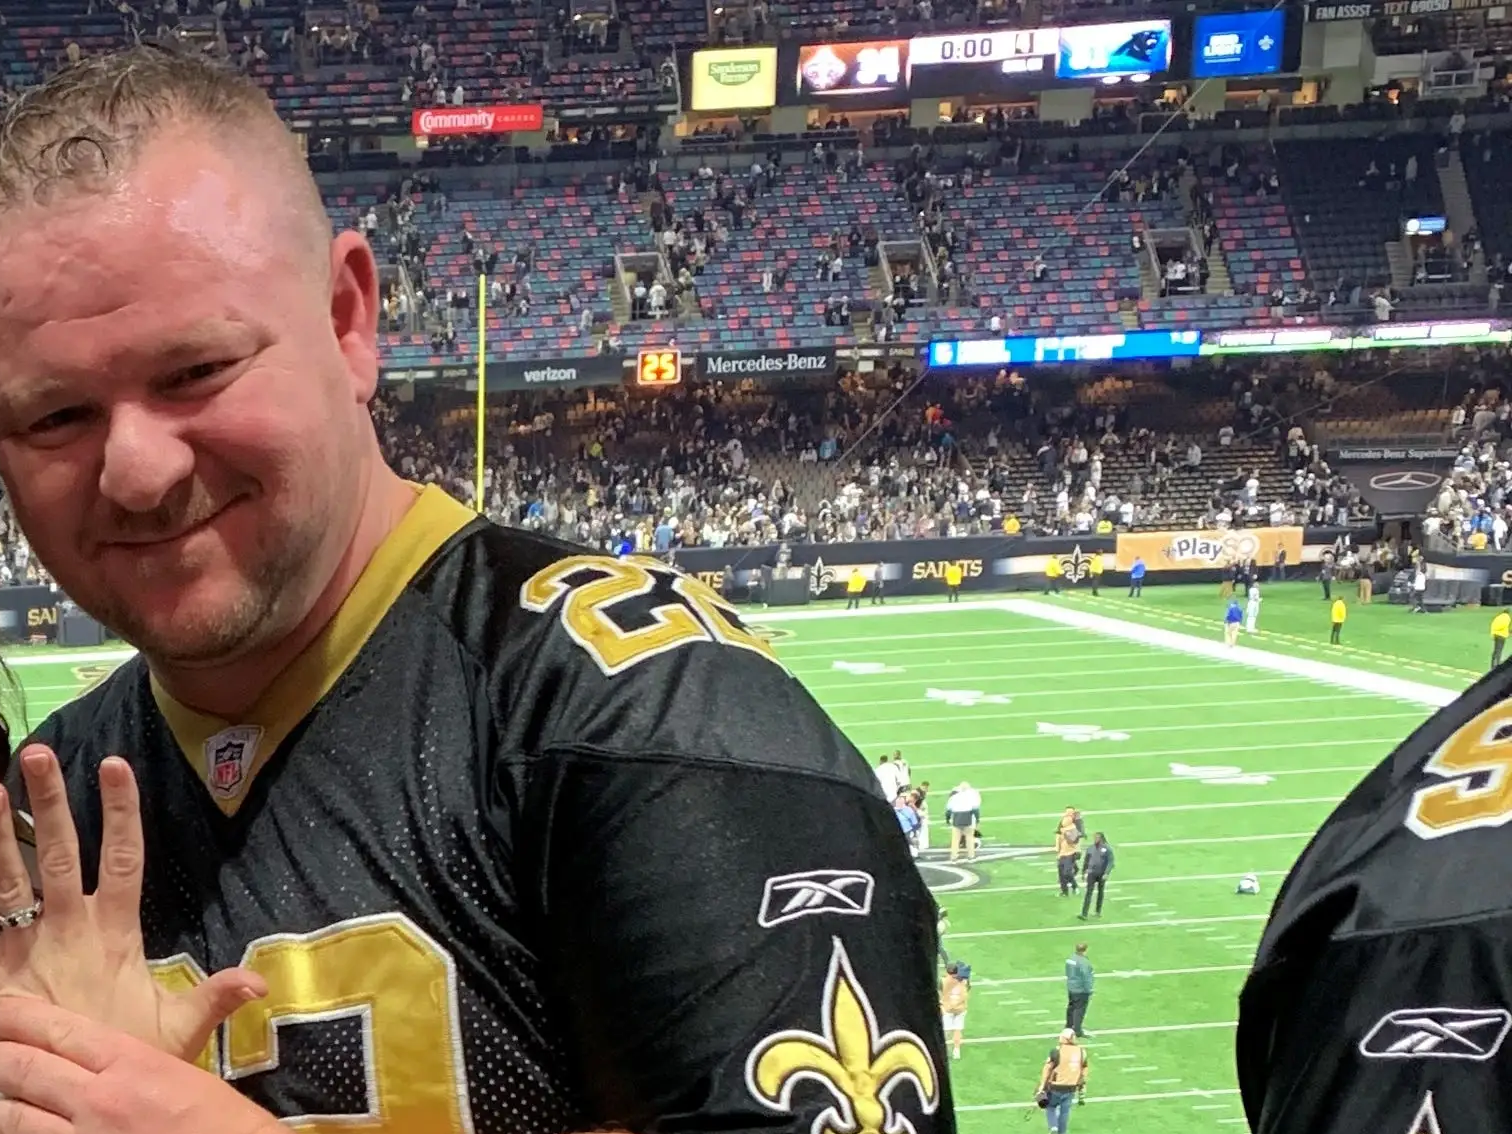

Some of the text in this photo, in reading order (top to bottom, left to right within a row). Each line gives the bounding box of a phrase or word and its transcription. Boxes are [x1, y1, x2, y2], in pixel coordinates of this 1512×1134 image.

[1316, 7, 1338, 20] FAN
[1338, 5, 1371, 18] ASSIST
[1384, 2, 1409, 15] TEXT
[941, 38, 993, 60] 0:00
[419, 109, 496, 131] Community
[642, 353, 676, 381] 25
[706, 354, 827, 374] Mercedes-Benz
[524, 367, 577, 383] verizon
